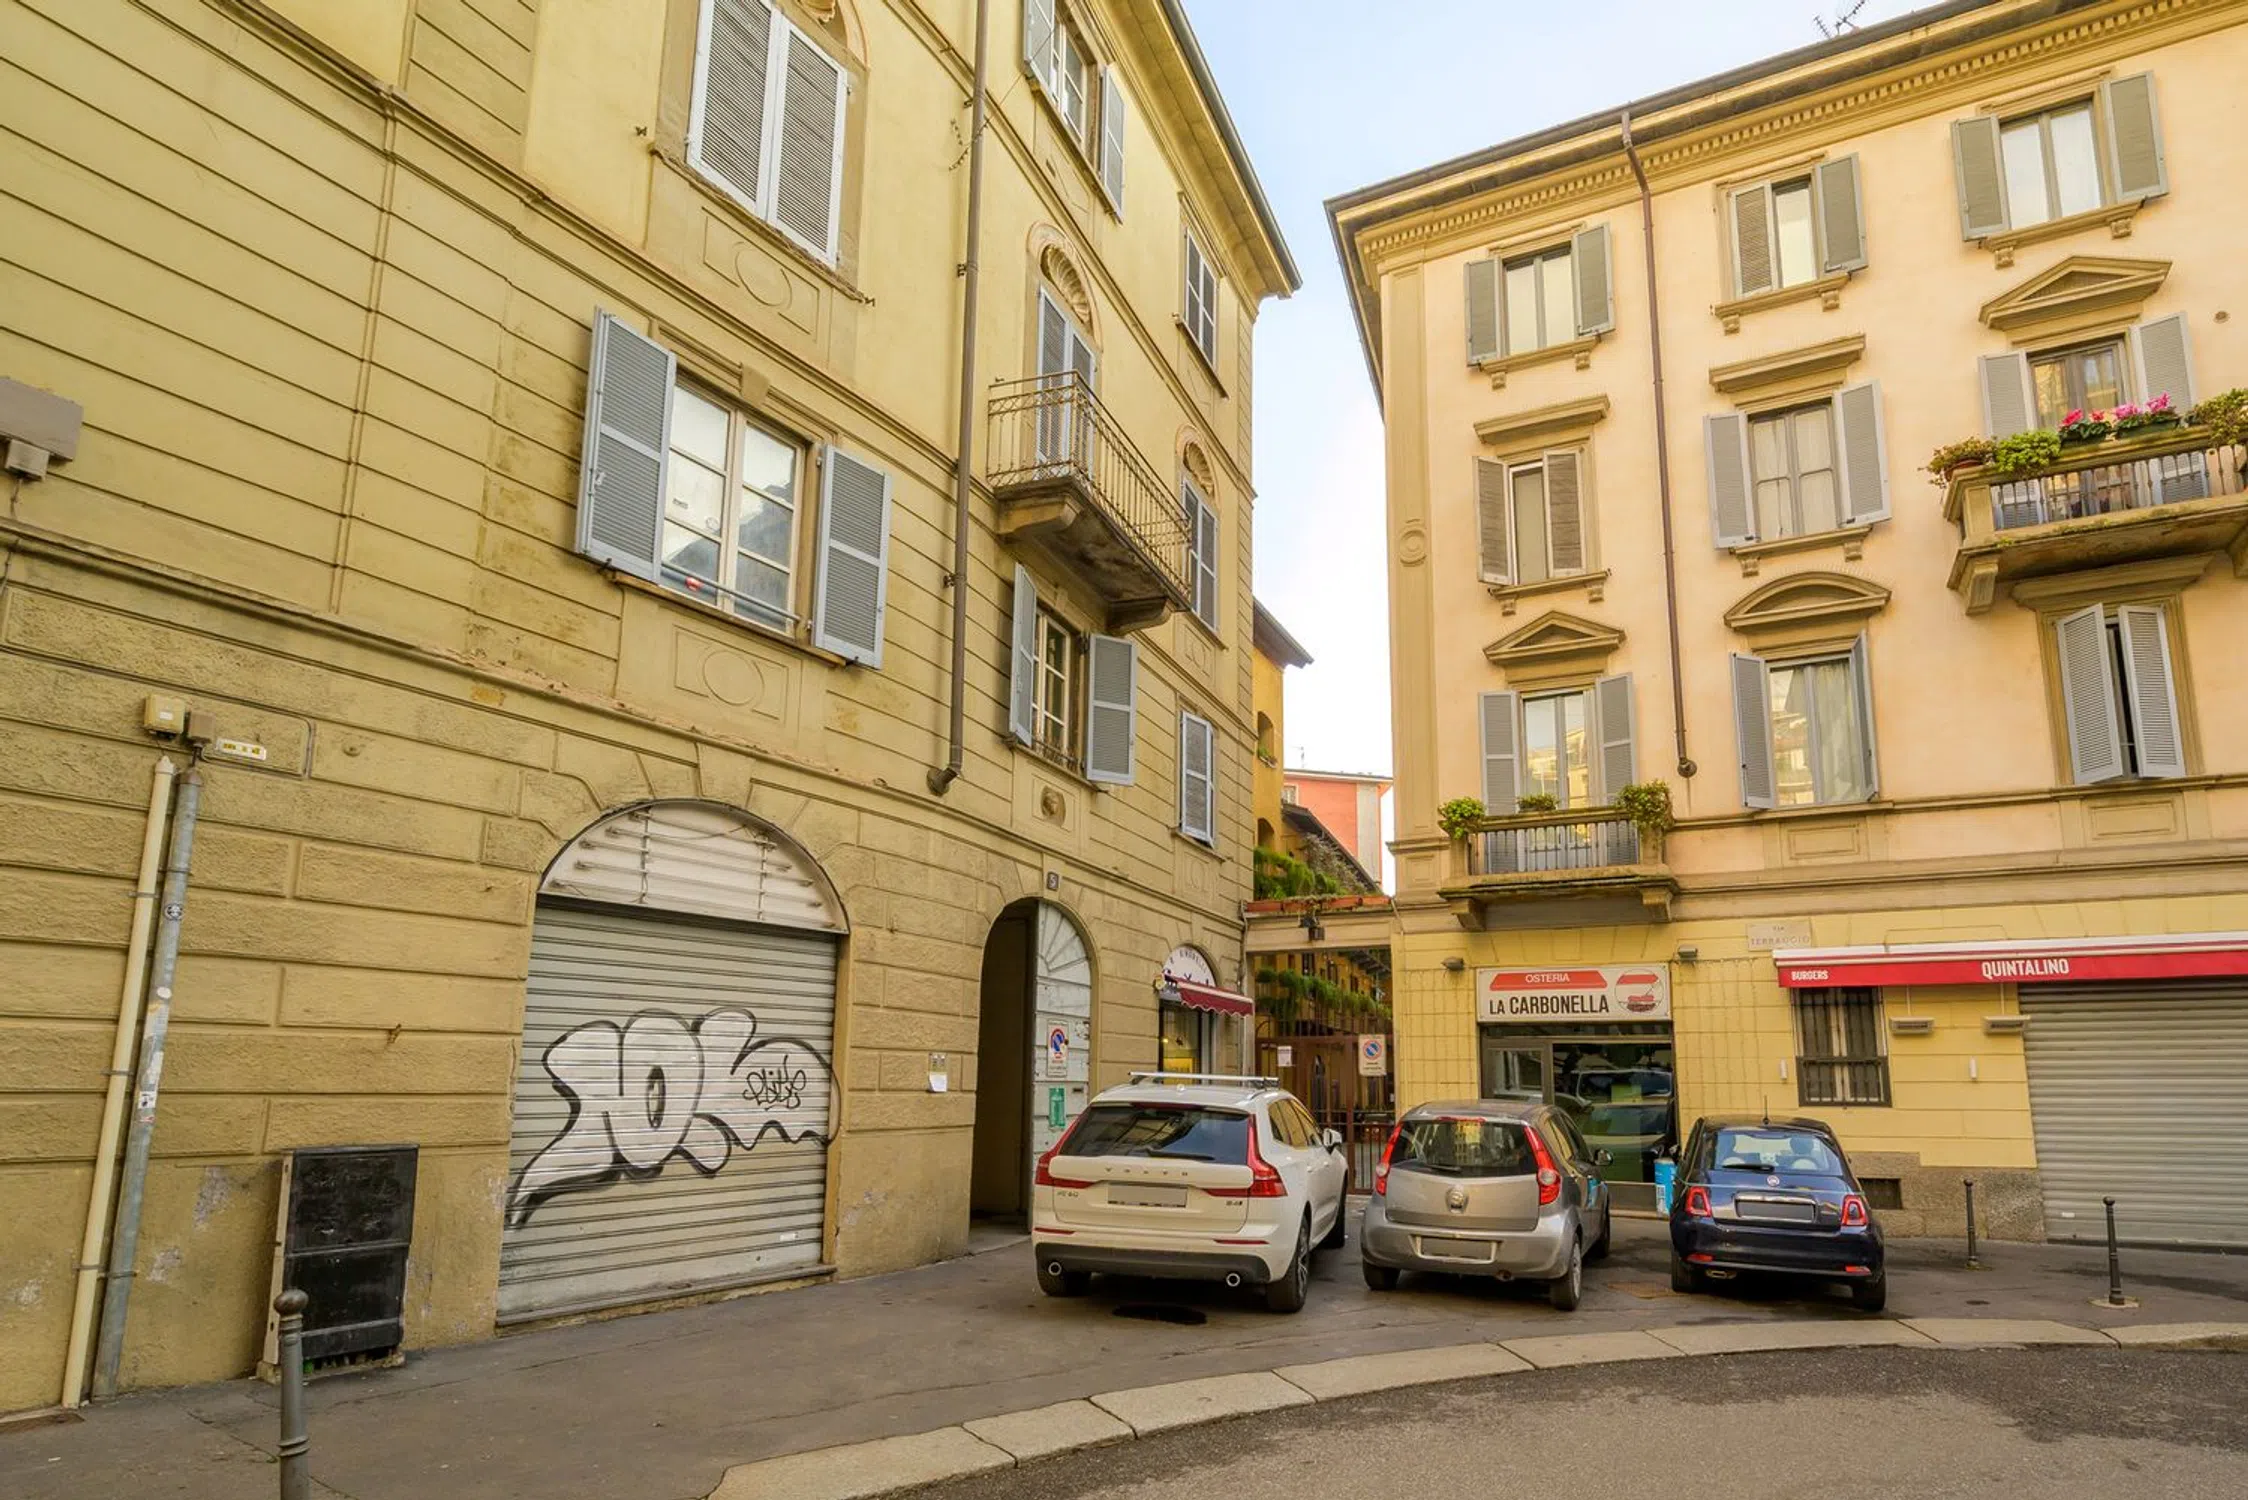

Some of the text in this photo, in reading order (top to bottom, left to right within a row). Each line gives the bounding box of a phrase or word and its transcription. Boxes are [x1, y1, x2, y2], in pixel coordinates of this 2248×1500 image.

[1791, 969, 1829, 981] BURGERS
[1981, 958, 2070, 980] QUINTALINO
[1525, 973, 1571, 984] OSTERIA
[1489, 994, 1610, 1015] LA CARBONELLA
